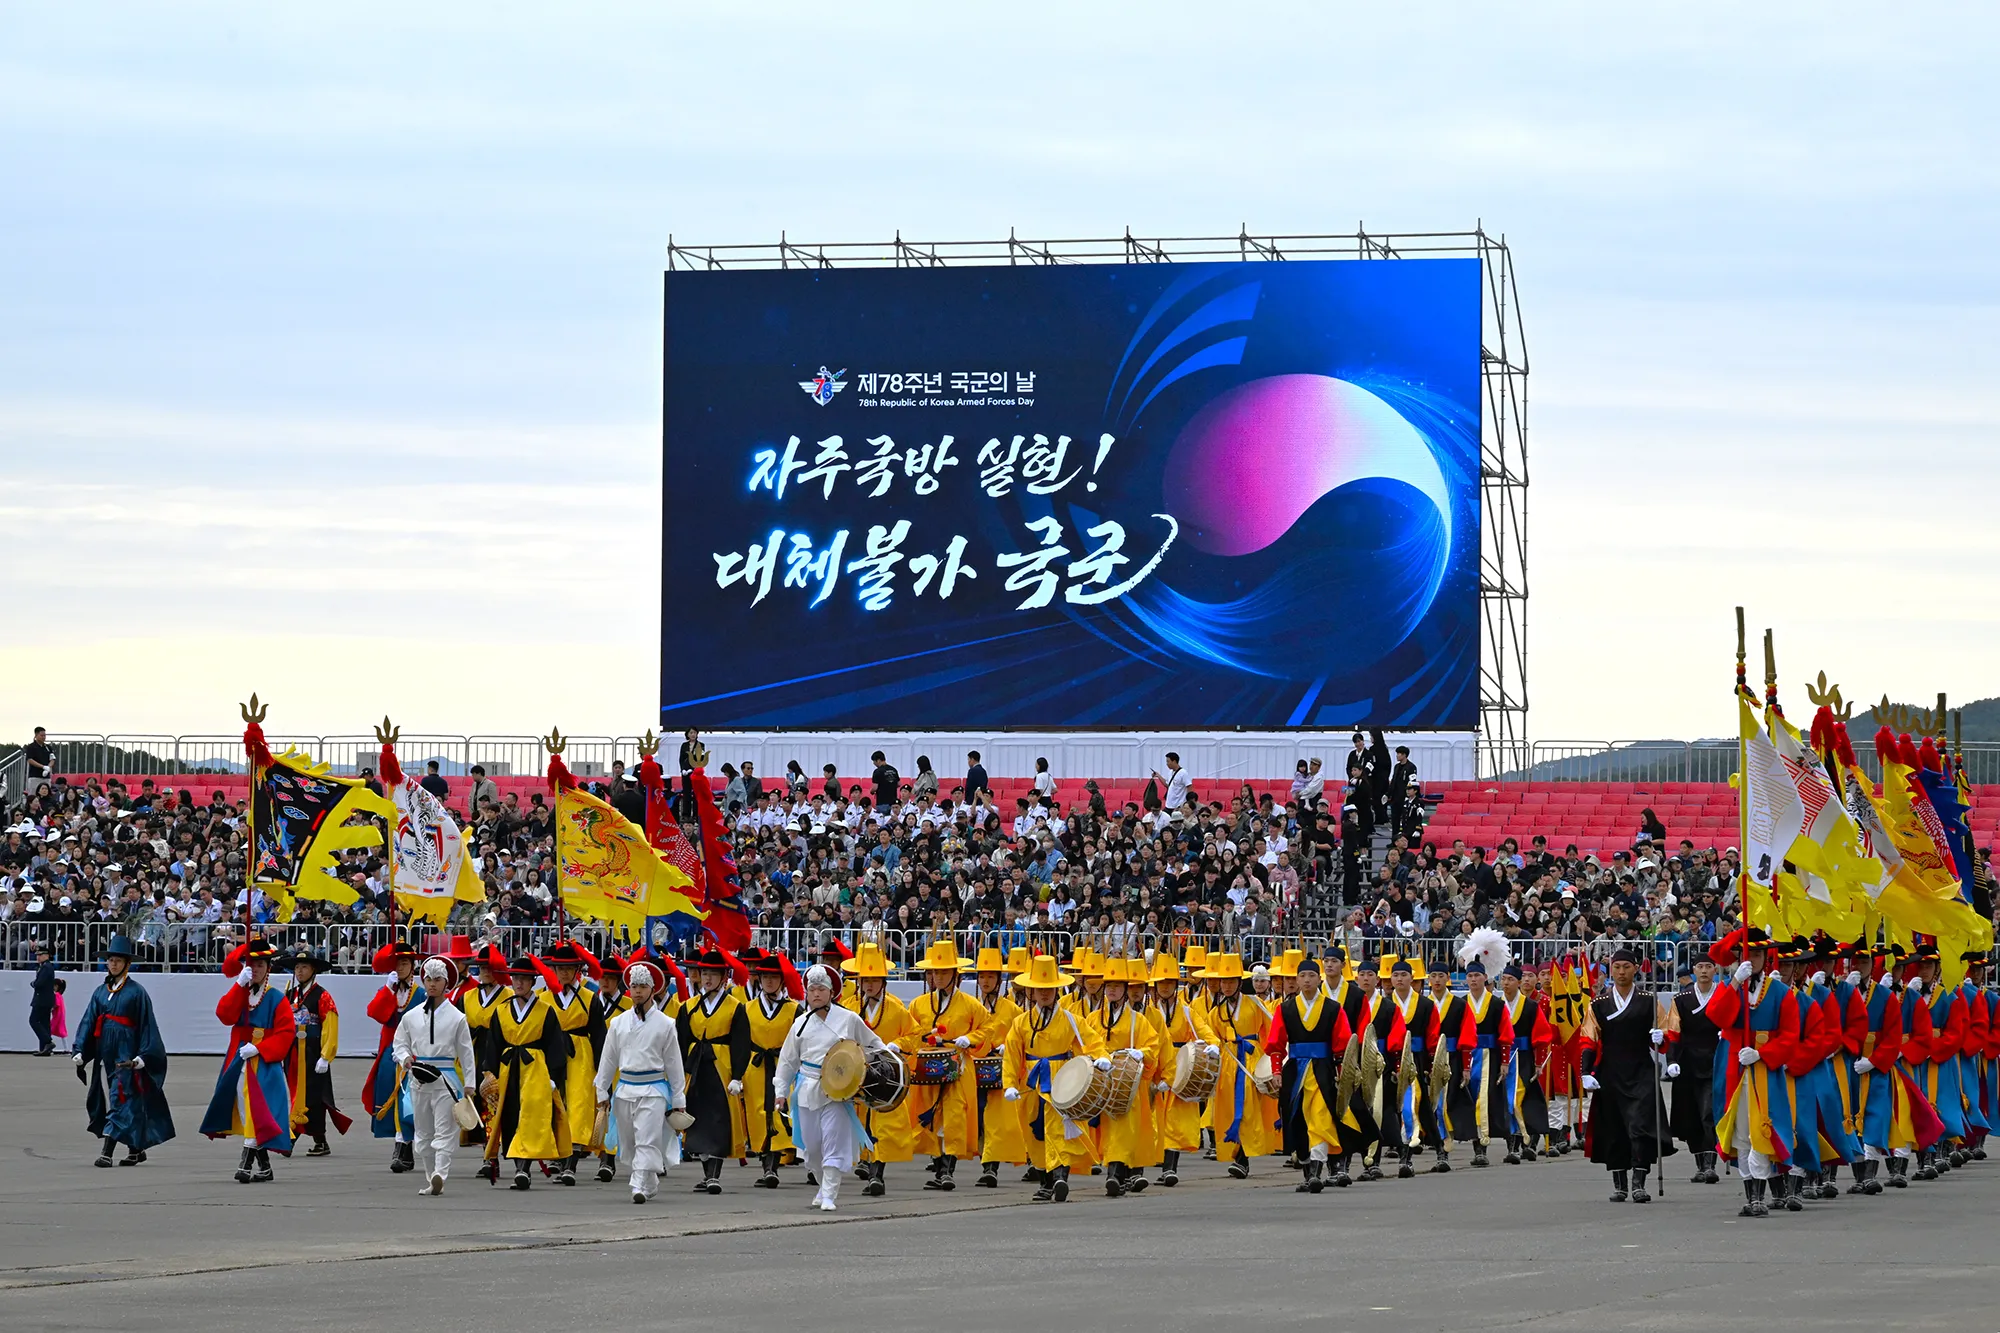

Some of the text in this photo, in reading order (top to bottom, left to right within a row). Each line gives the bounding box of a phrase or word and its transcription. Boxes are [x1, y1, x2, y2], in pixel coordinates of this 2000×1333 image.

[858, 371, 1037, 394] 제78주년 국군의 날
[859, 397, 1035, 409] 78th Republic of Korea Armed Forces Day
[748, 434, 959, 501] 자주국방
[712, 513, 1179, 611] 대체불가 국군
